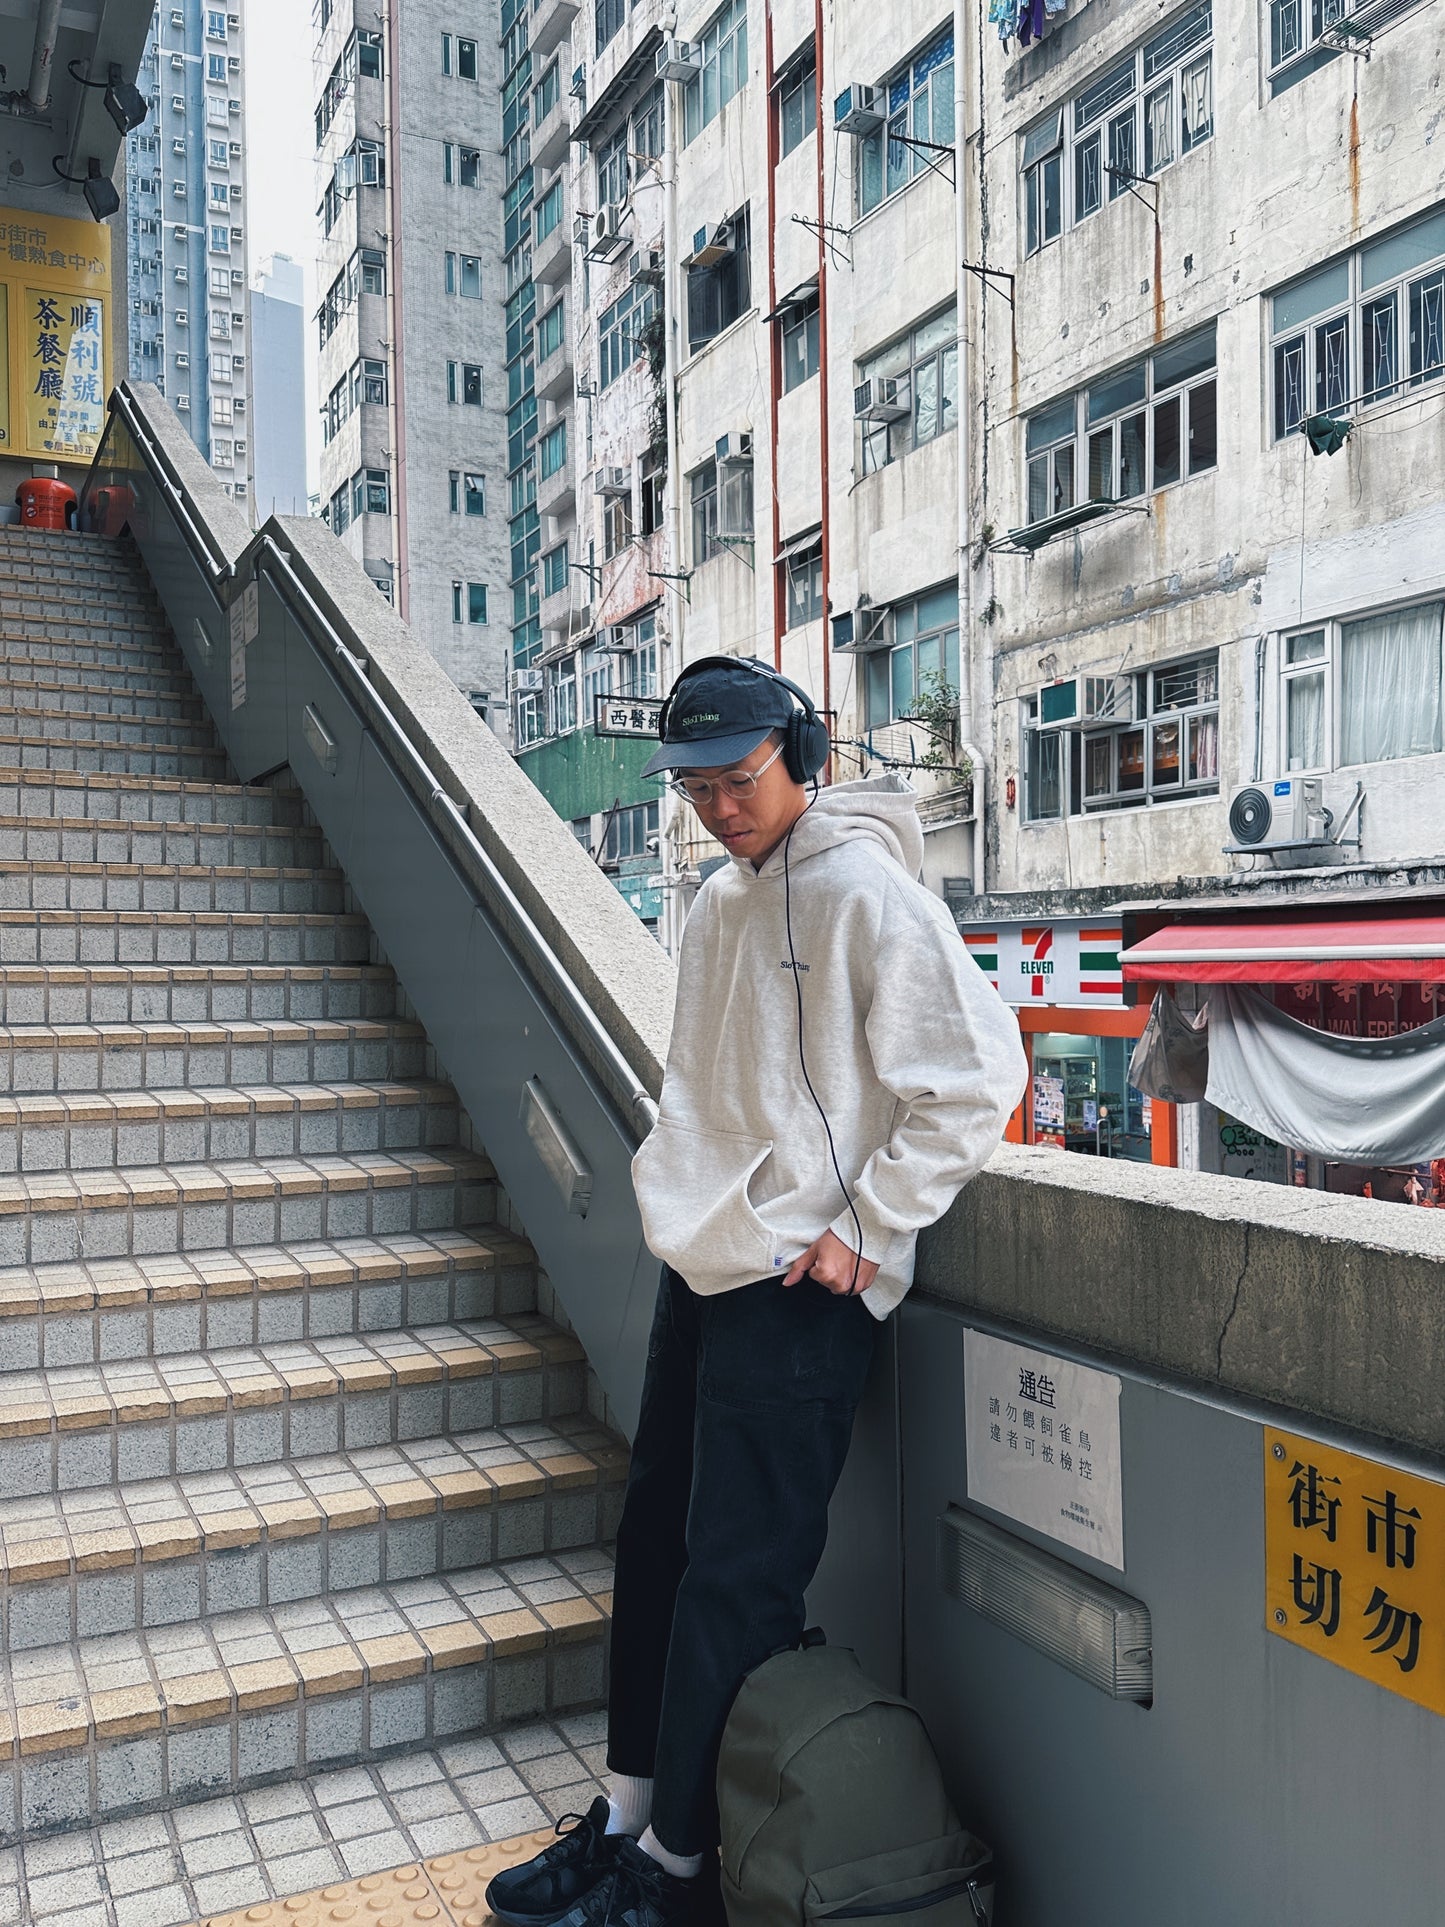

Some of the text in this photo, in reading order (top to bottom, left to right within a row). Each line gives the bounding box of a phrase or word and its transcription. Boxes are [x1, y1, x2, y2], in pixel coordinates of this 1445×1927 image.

[33, 298, 67, 401] 茶餐廳
[70, 304, 103, 406] 順利號
[1018, 1367, 1057, 1409] 通告
[990, 1421, 1093, 1481] 違者可被檢控
[1287, 1460, 1422, 1569] 街市
[1288, 1552, 1423, 1673] 切勿
